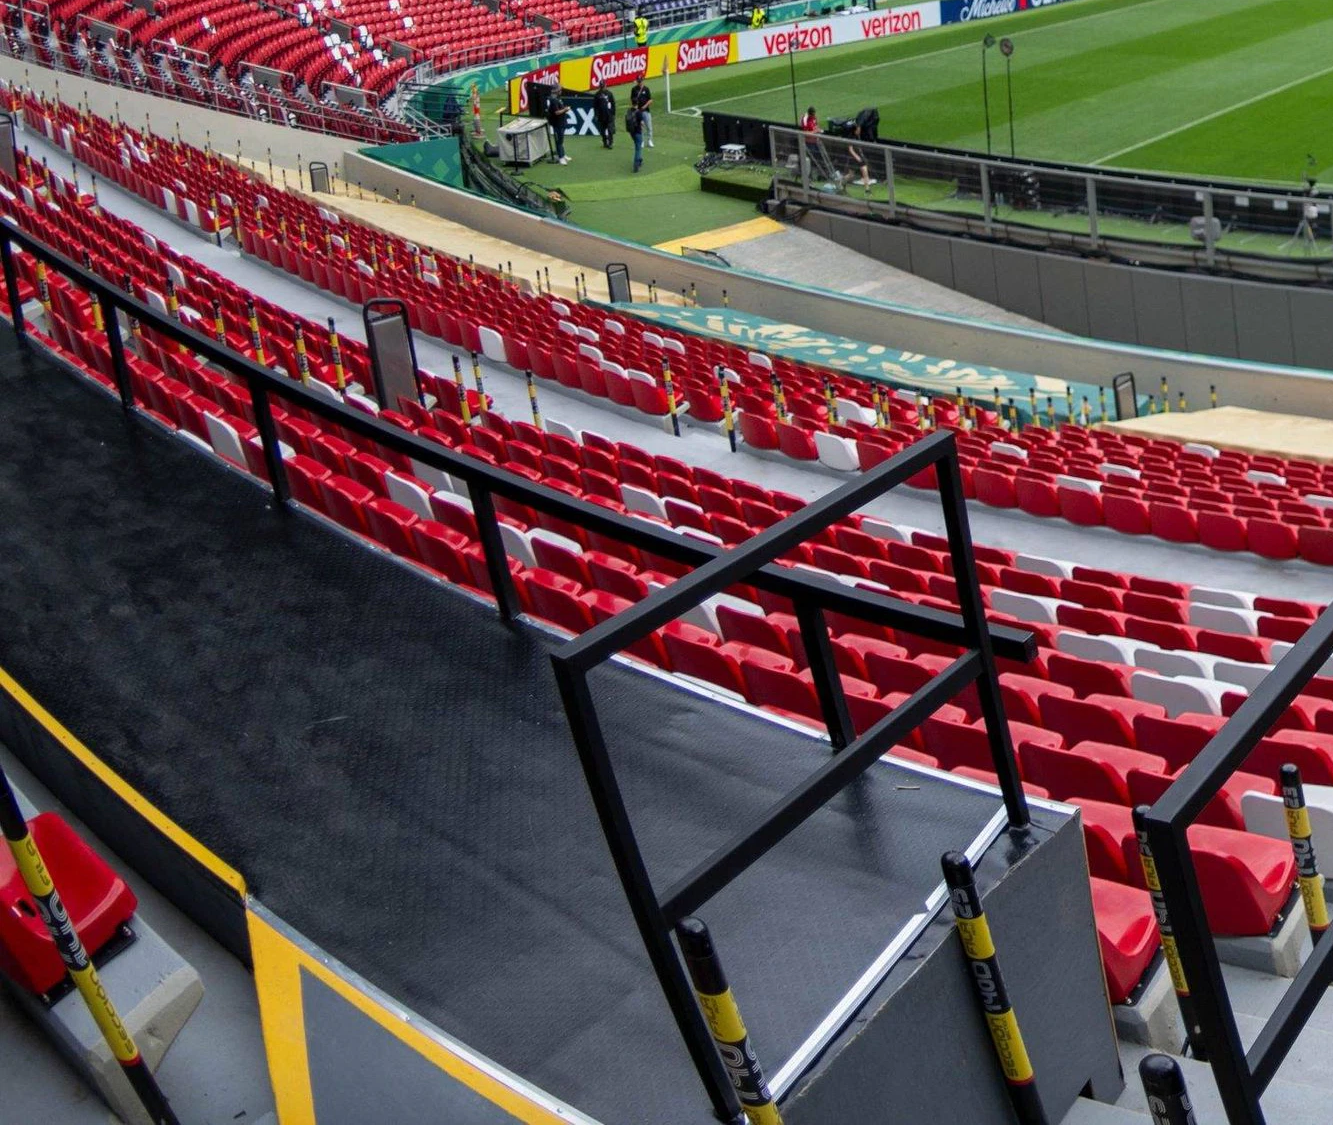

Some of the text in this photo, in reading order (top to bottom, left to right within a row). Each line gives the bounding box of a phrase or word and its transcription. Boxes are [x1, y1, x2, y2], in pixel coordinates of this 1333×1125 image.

[763, 22, 832, 55] verizon
[861, 9, 920, 38] verizon
[591, 52, 646, 88] Sabritas
[678, 38, 728, 70] Sabritas
[1283, 786, 1297, 808] 23
[25, 838, 51, 886] FILA
[1292, 838, 1317, 876] 140
[958, 921, 978, 957] FILA
